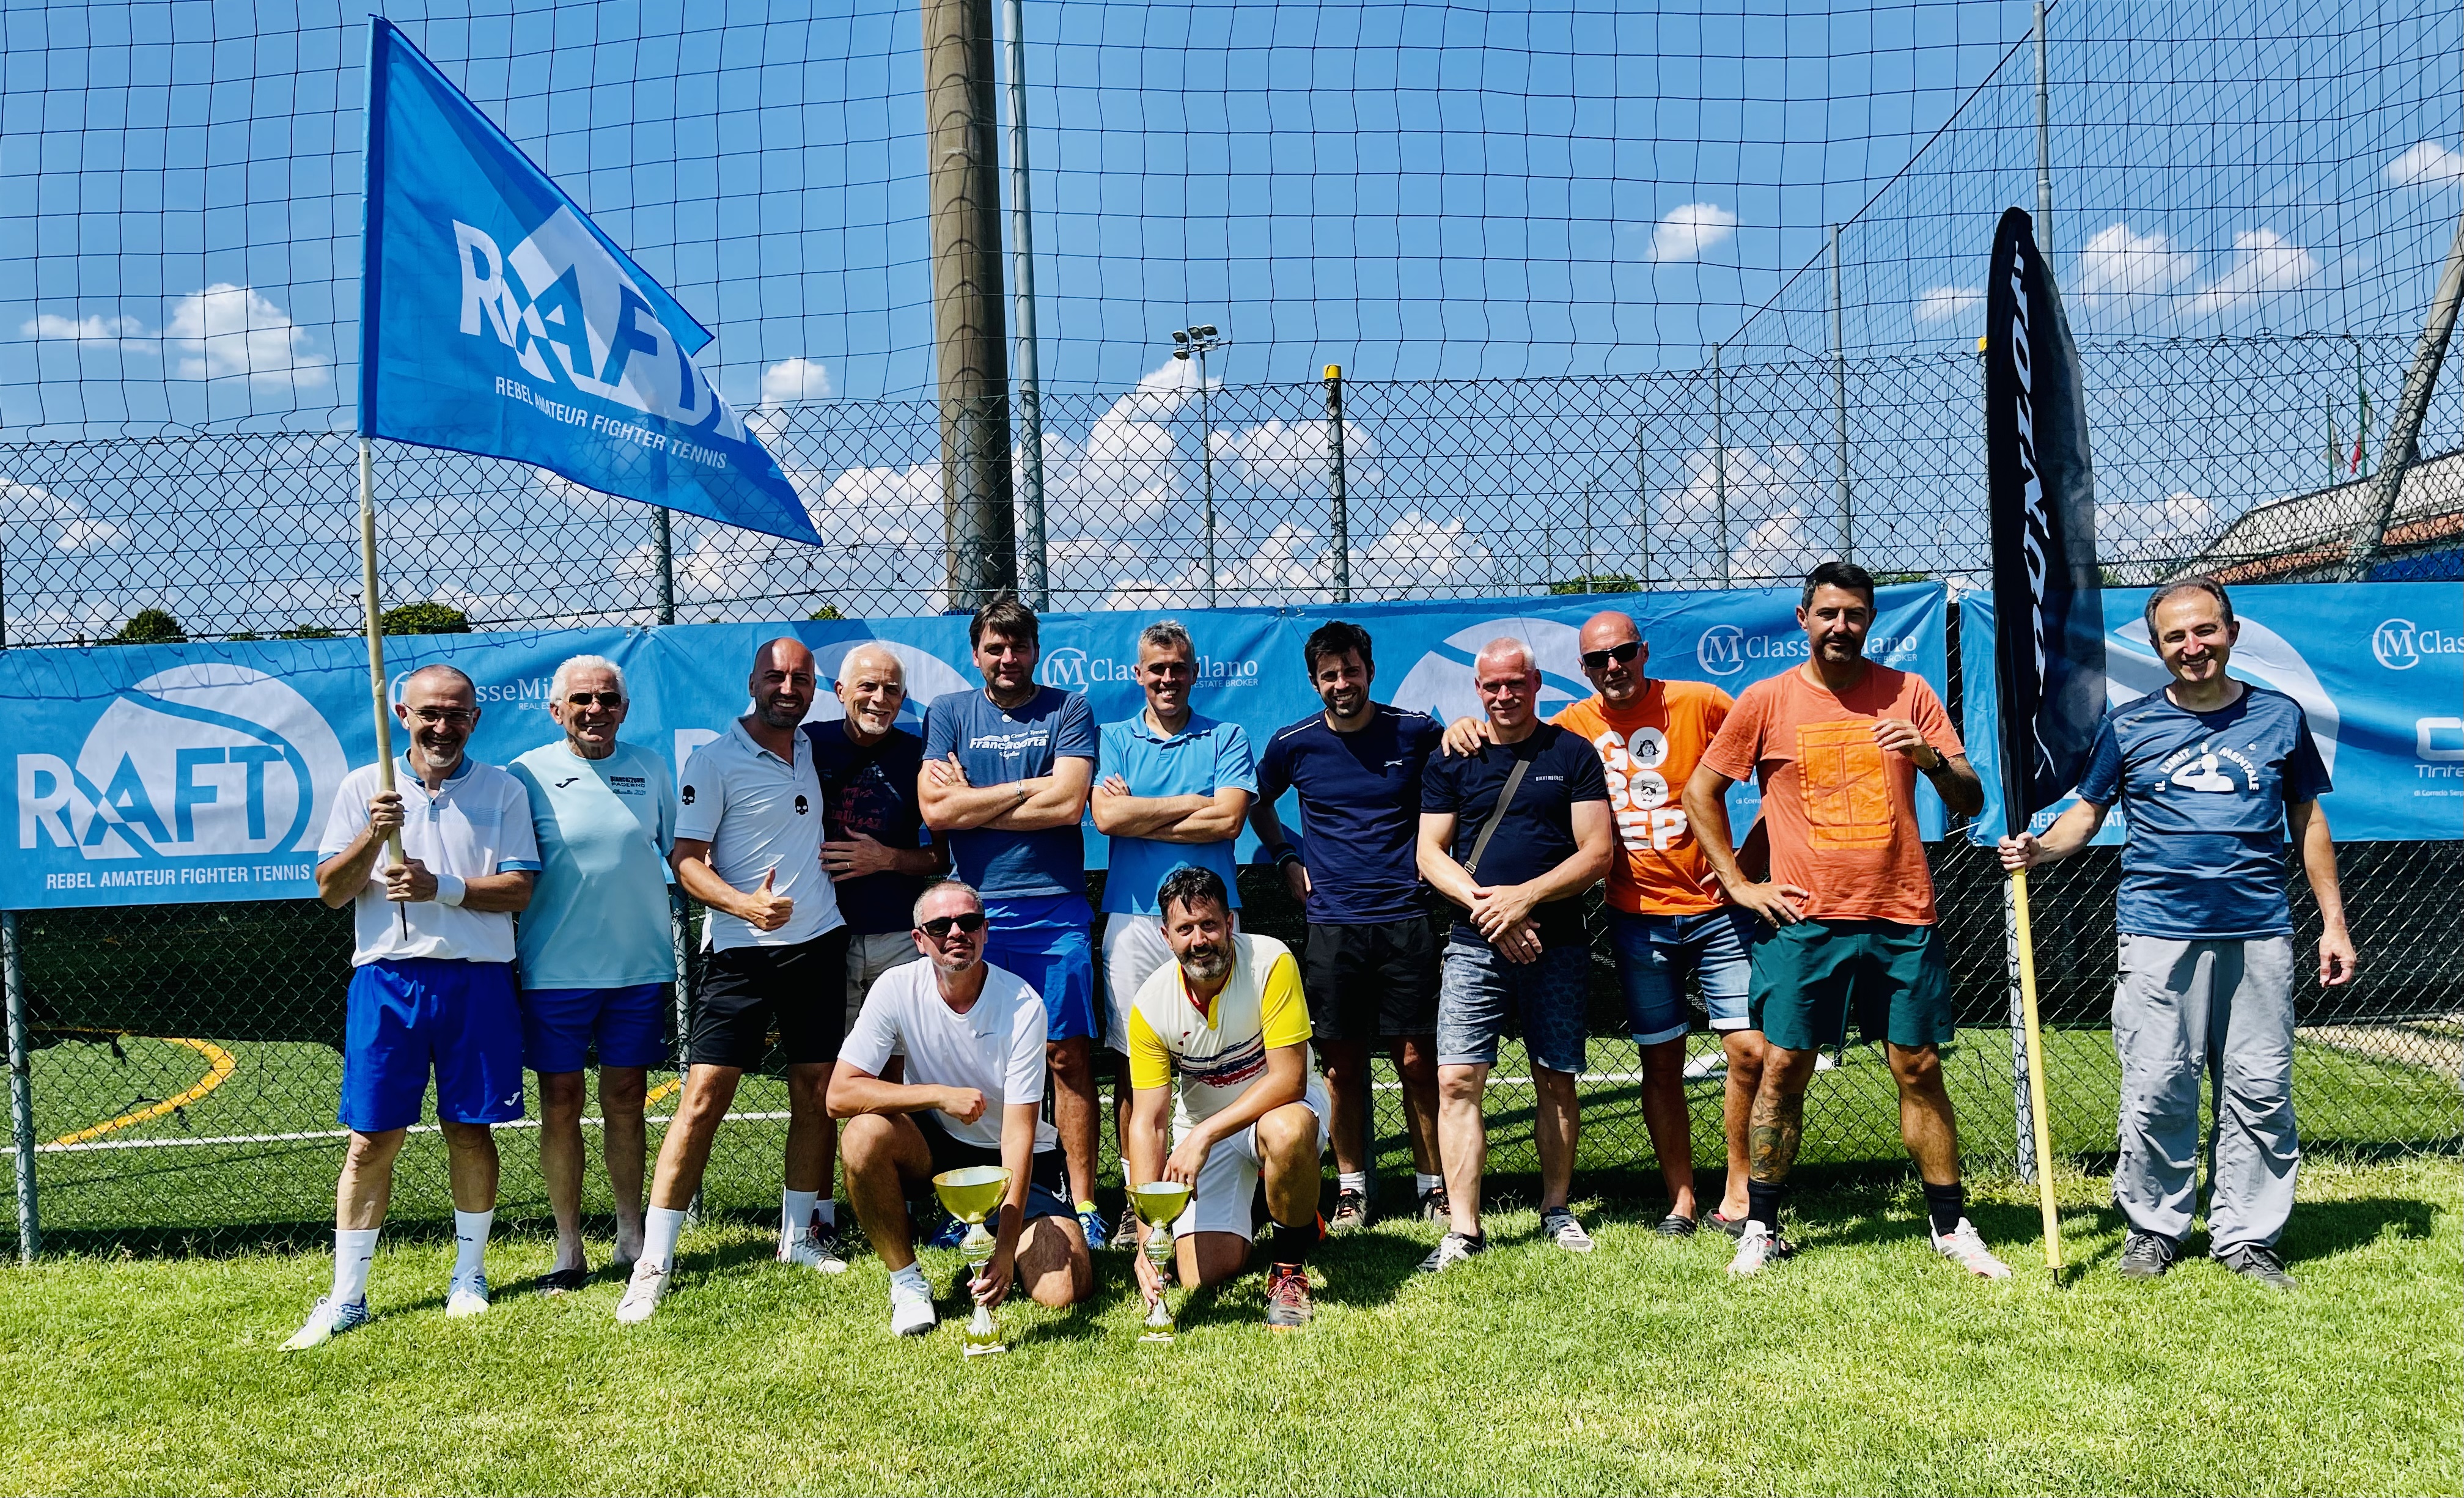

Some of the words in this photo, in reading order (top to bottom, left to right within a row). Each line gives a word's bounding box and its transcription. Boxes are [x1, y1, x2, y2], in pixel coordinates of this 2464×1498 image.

[495, 376, 533, 406] REBEL
[534, 390, 588, 428] AMATEUR
[591, 413, 666, 452] FIGHTER
[671, 439, 727, 469] TENNIS
[1746, 635, 1917, 658] Classlano
[1883, 653, 1918, 663] BROKER
[1226, 678, 1259, 687] BROKER
[969, 737, 1047, 750] Franciacorta
[2218, 746, 2260, 791] MENTALE
[17, 744, 285, 850] RAFT
[46, 872, 95, 889] REBEL
[100, 868, 175, 887] AMATEUR
[181, 866, 248, 884] FIGHTER
[253, 864, 310, 882] TENNIS
